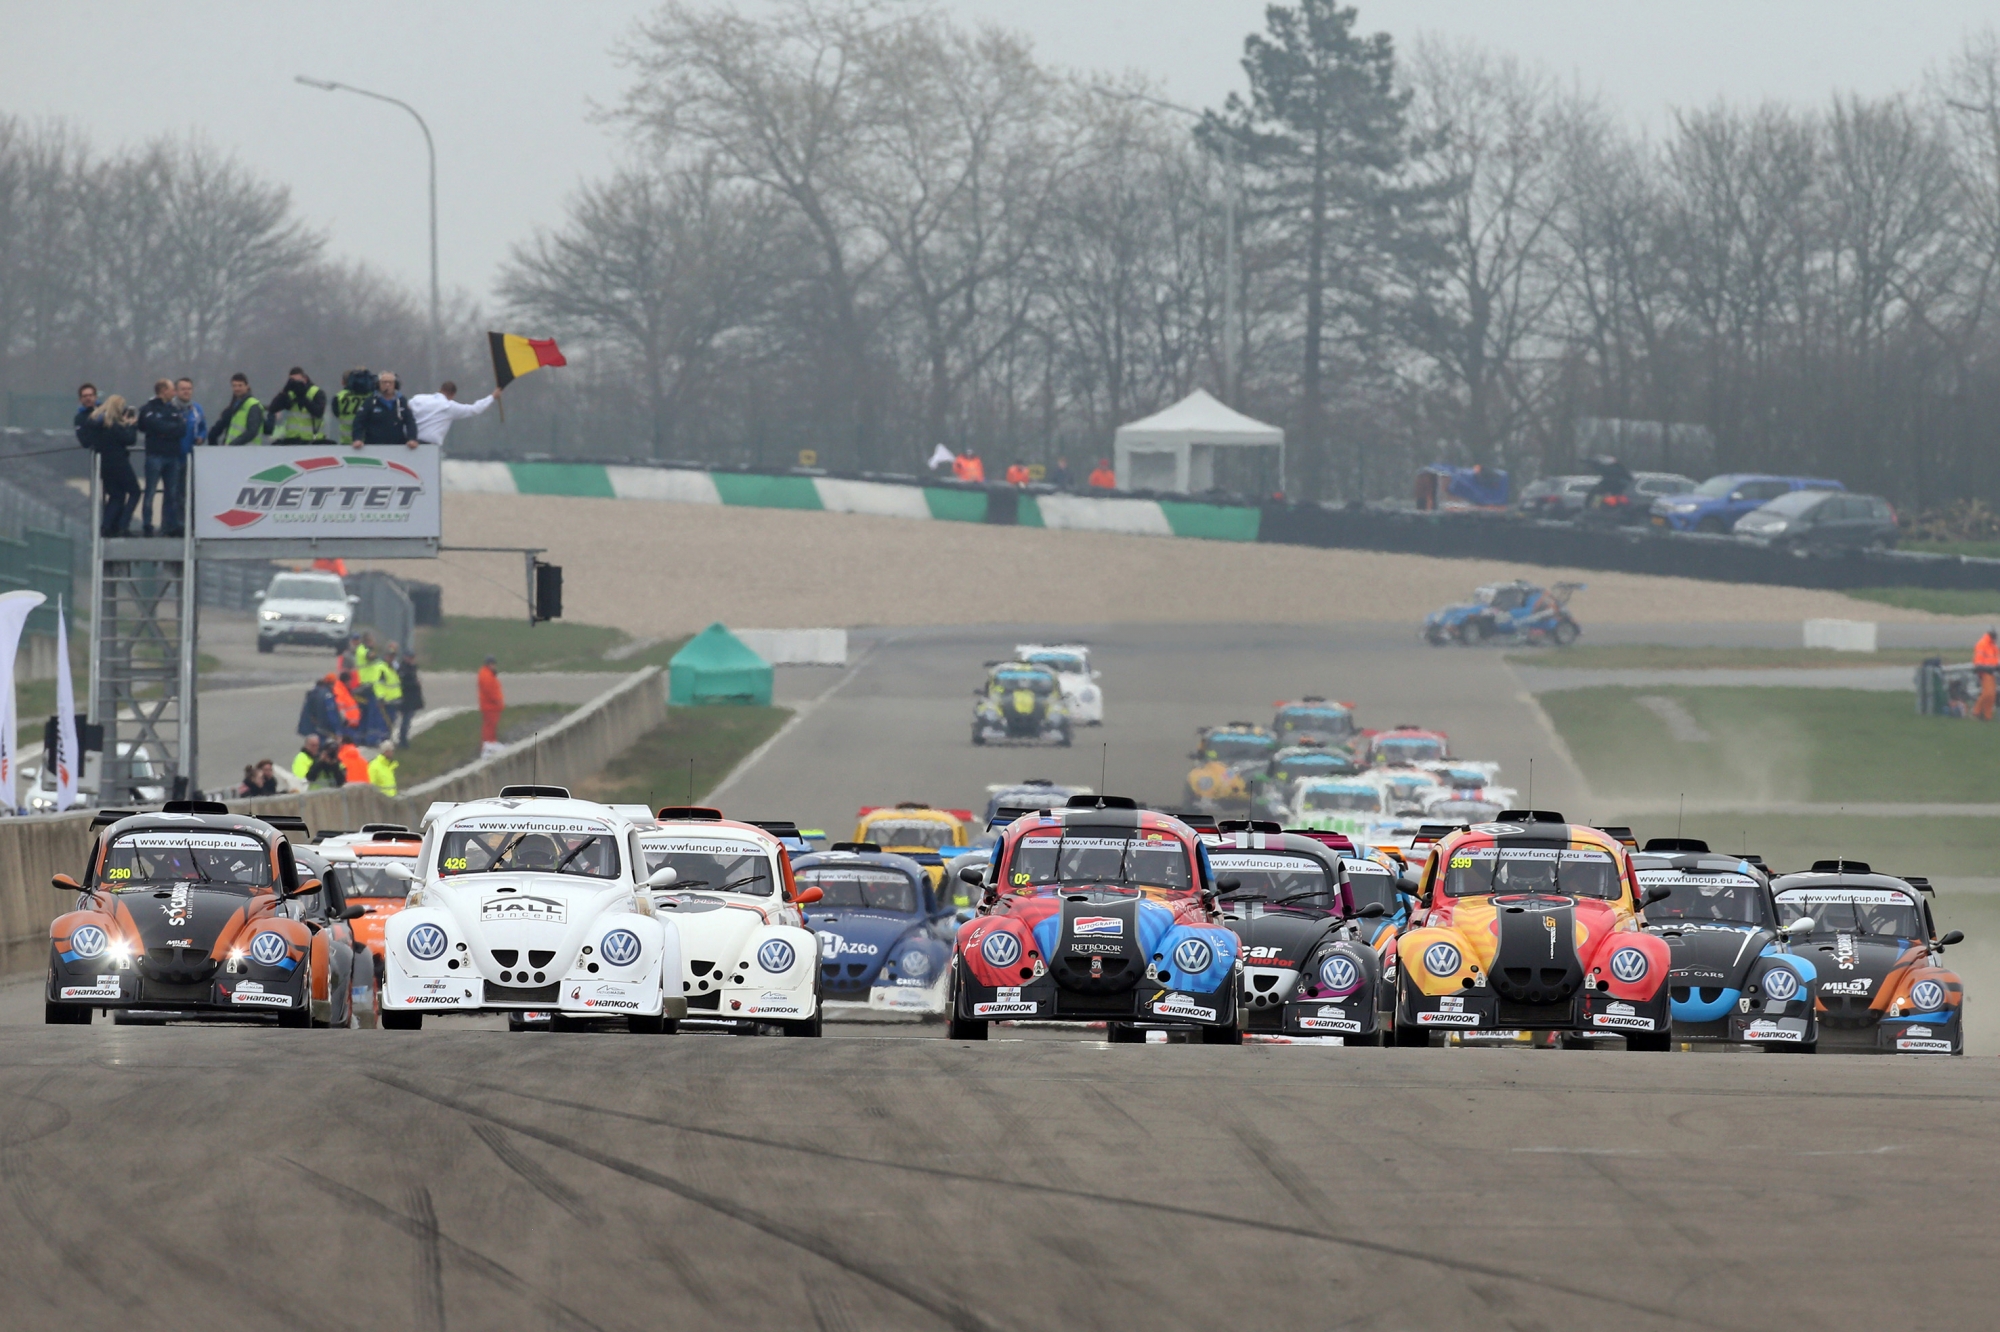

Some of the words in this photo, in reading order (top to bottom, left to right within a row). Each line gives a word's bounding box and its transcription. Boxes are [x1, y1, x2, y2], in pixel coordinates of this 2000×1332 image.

[235, 486, 422, 507] METTET
[479, 822, 583, 832] www.vwfuncup.eu
[140, 837, 237, 848] www.vwfuncup.eu
[641, 843, 738, 853] www.vwfuncup.eu
[1483, 850, 1580, 860] www.vwfuncup.eu
[444, 857, 467, 869] 426
[1450, 858, 1472, 869] 399
[109, 868, 131, 879] 280
[1014, 873, 1030, 885] 02
[1639, 873, 1733, 884] www.vwfuncup.eu
[1798, 894, 1886, 903] www.vwfuncup.eu
[482, 904, 562, 914] HALL
[485, 912, 563, 921] concept
[1076, 920, 1121, 931] AUTOGRAPHE
